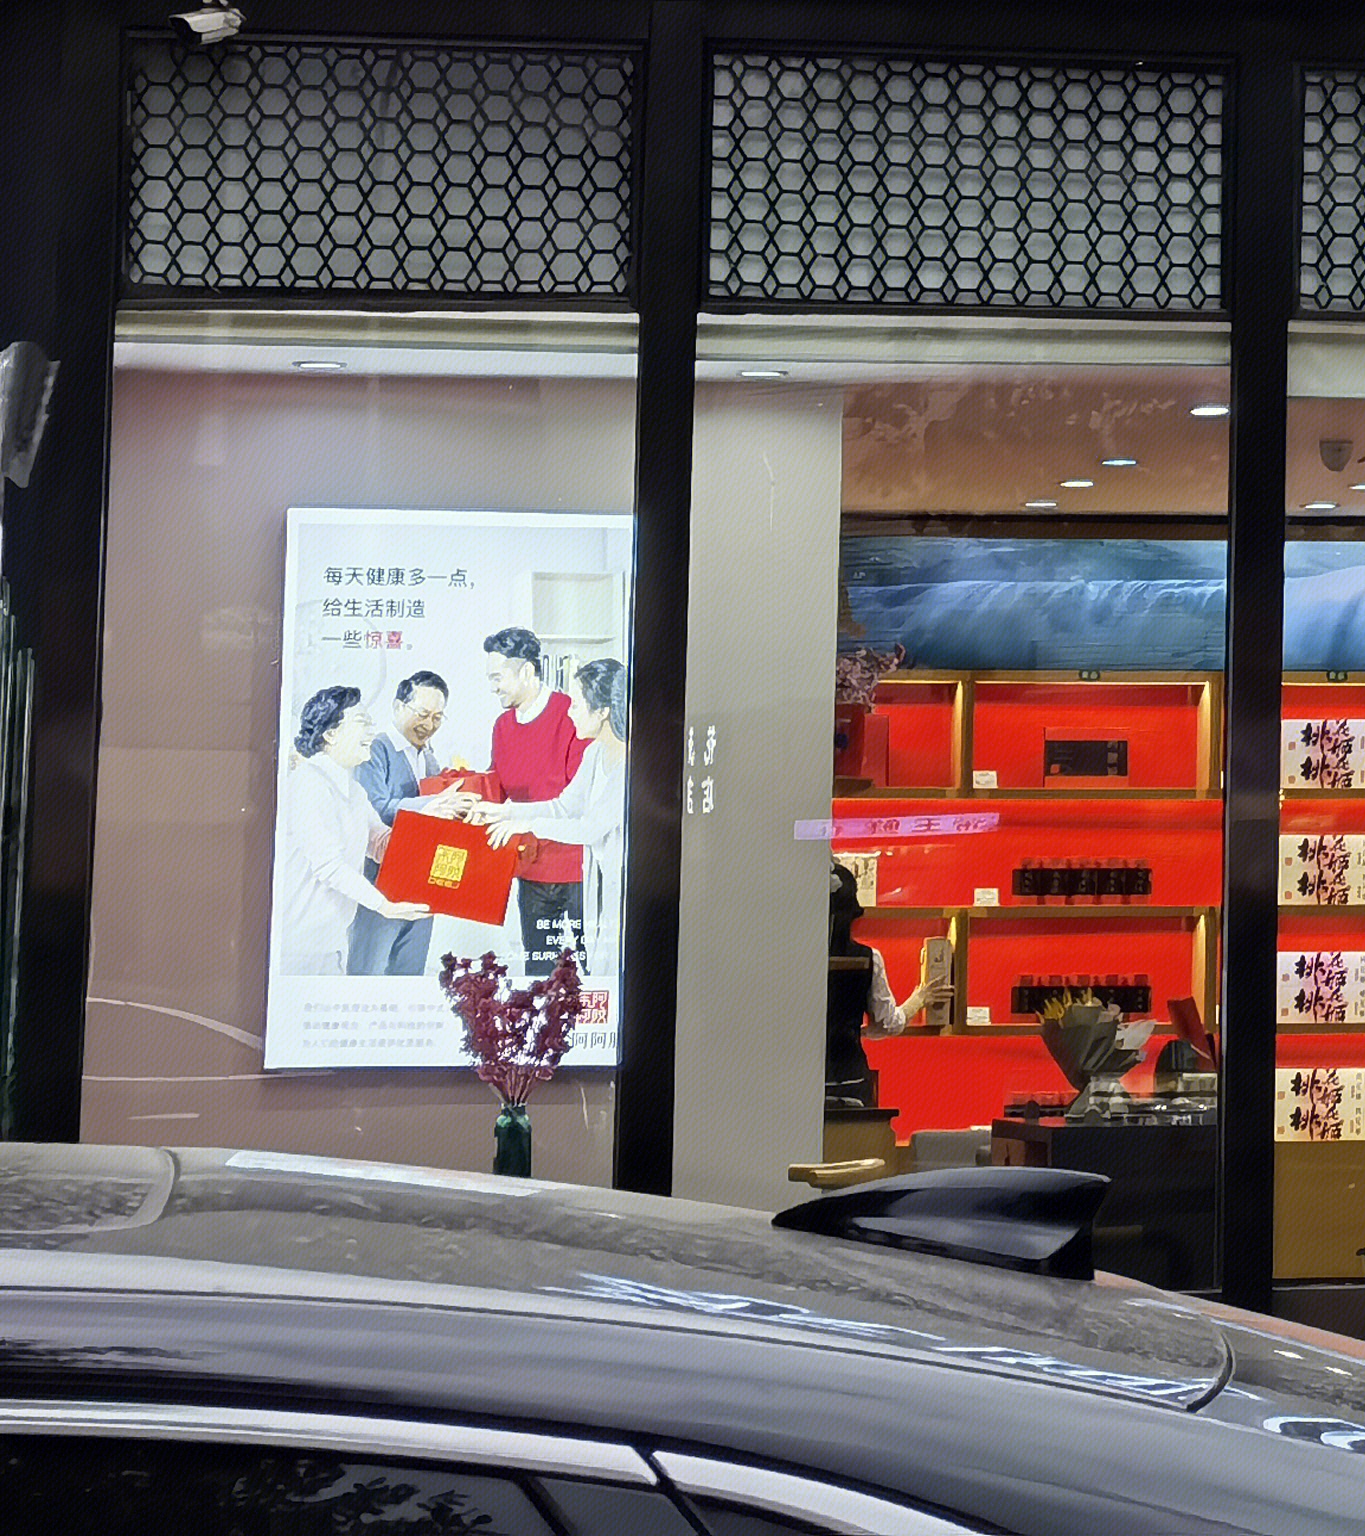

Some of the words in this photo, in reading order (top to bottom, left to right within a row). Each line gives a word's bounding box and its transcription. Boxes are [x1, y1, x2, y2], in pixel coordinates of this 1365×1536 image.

[322, 597, 425, 618] 给生活制造
